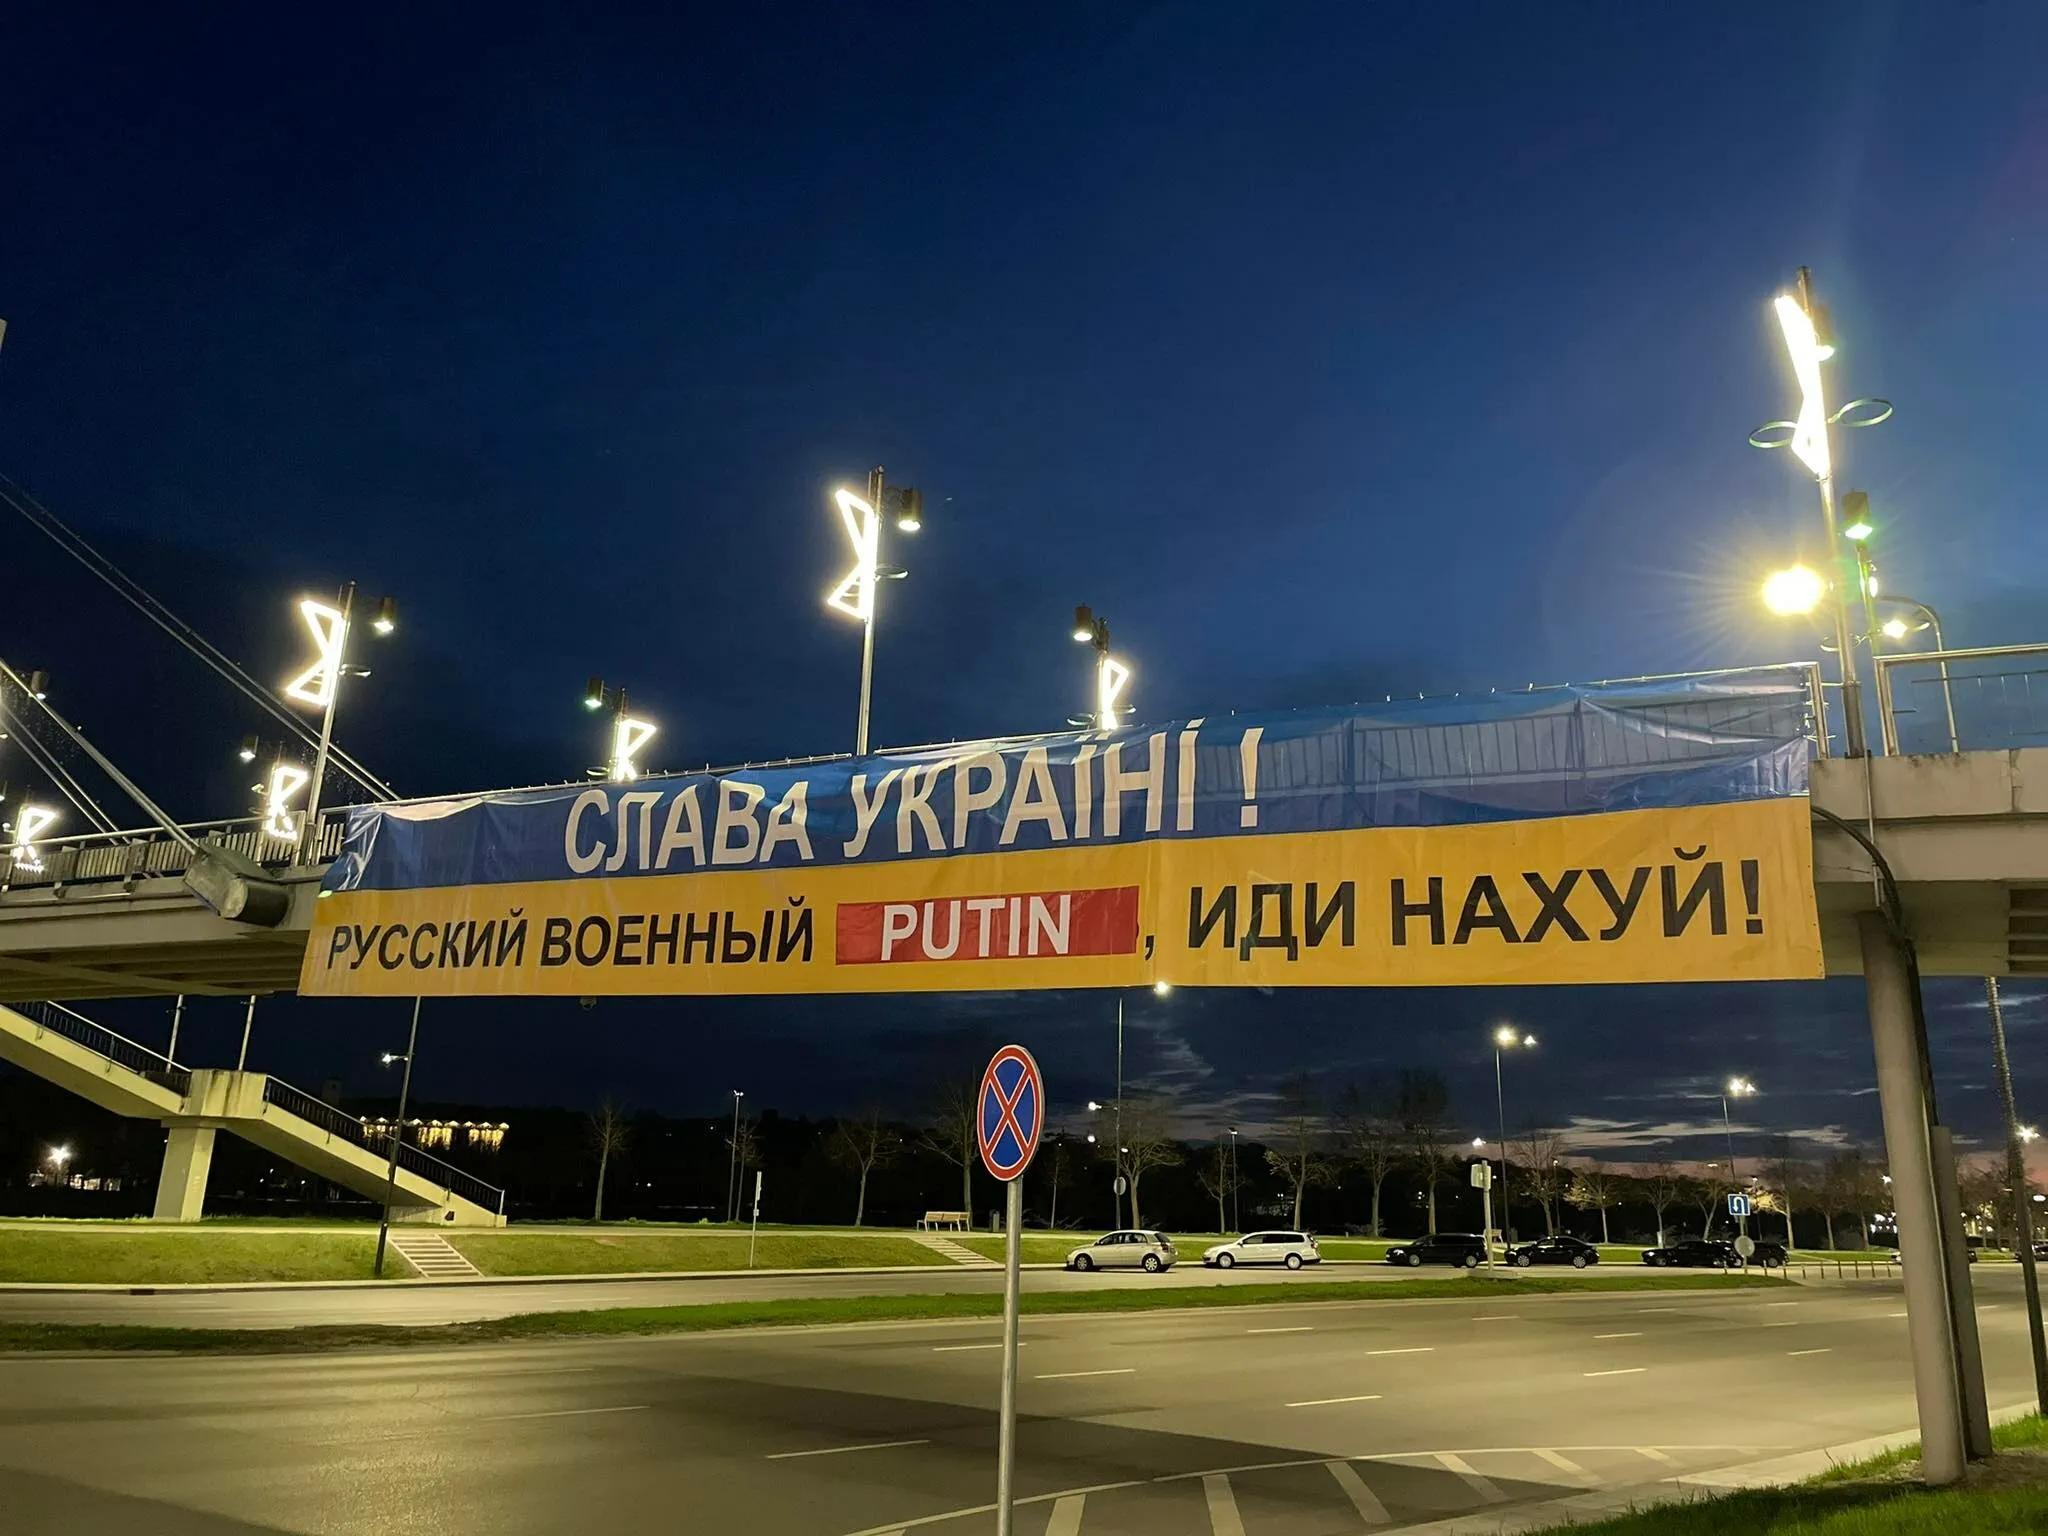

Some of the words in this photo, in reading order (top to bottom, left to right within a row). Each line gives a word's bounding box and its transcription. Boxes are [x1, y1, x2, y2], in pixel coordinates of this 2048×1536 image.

[564, 777, 815, 875] СЛАВА
[326, 907, 528, 972] РУССКИЙ
[539, 895, 815, 968] ВОЕННЫЙ
[1187, 880, 1356, 962] ИДИ
[1390, 844, 1765, 946] НАХУЙ!
